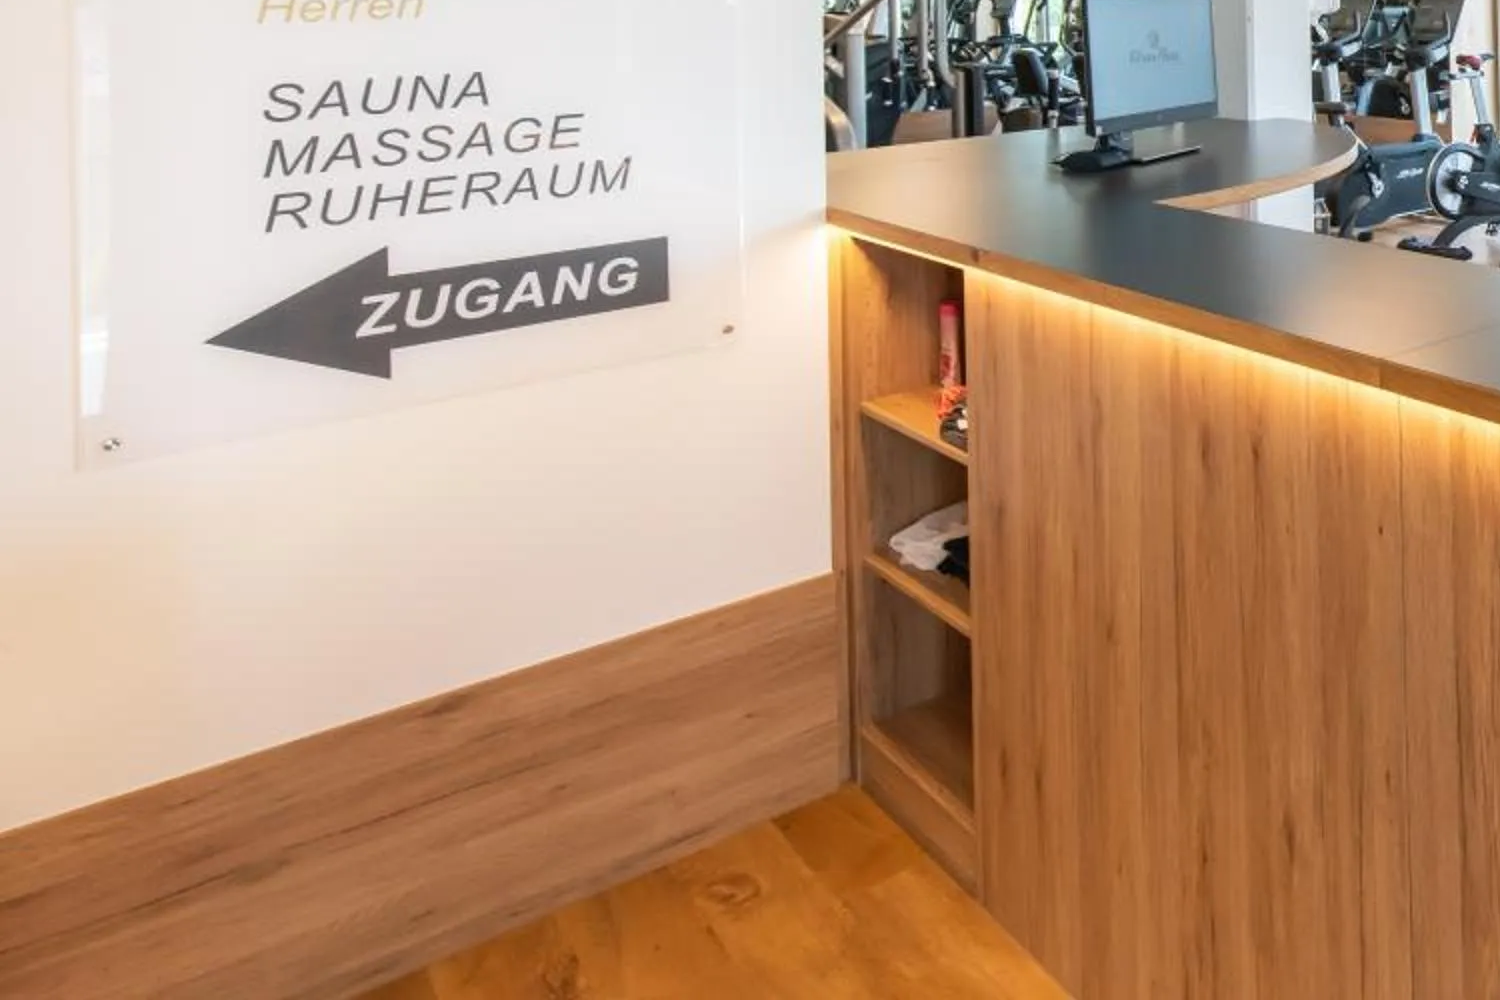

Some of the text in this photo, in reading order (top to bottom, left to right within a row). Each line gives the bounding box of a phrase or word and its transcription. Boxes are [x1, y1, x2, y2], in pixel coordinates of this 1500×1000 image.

[262, 71, 491, 124] SAUNA
[262, 112, 586, 180] MASSAGE
[264, 156, 633, 234] RUHERAUM
[355, 256, 640, 340] ZUGANG
